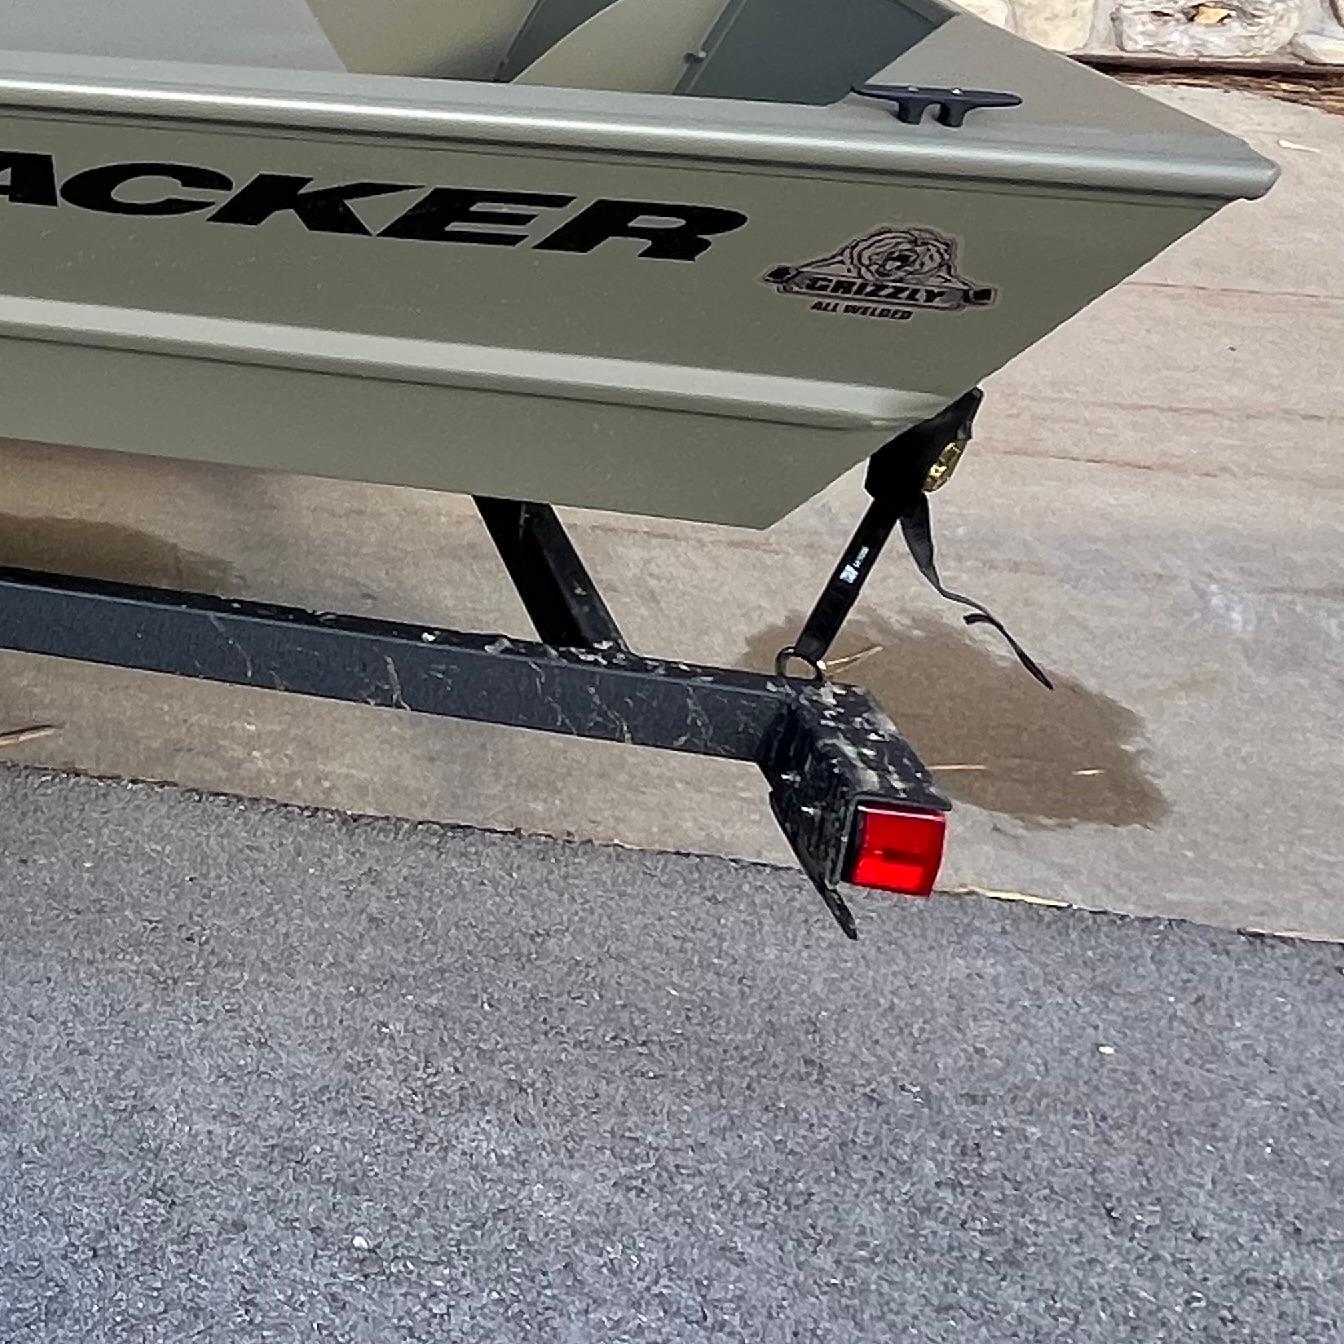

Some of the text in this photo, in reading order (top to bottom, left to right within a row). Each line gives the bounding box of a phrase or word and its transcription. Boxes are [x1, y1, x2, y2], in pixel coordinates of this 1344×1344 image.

[804, 275, 946, 304] GRIZZLY
[810, 301, 913, 321] ALL WELDED
